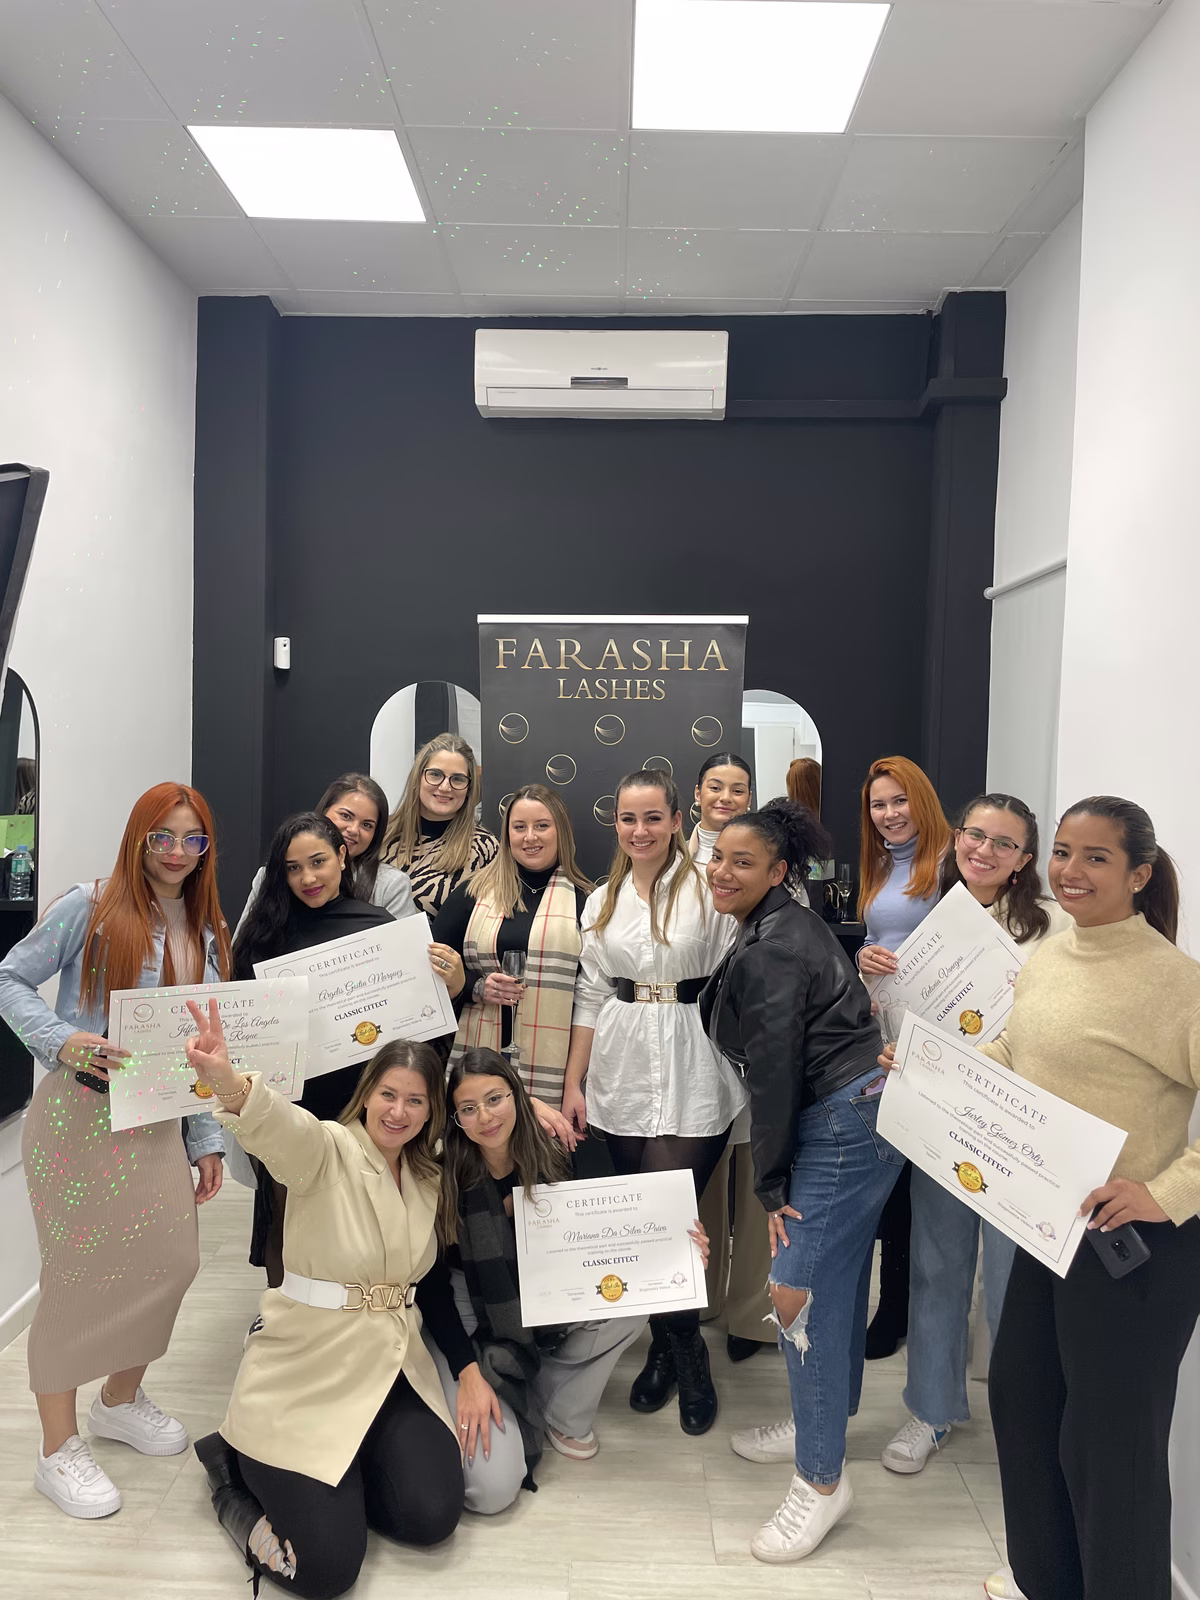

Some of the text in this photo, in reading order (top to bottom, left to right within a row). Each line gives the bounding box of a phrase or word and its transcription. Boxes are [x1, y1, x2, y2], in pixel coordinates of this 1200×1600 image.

[495, 638, 728, 671] FARASHA
[557, 678, 666, 700] LASHES
[309, 944, 382, 972] CERTIFICATE
[894, 932, 942, 985] CERTIFICATE
[329, 966, 350, 975] certificate
[171, 999, 254, 1014] CETIICATE
[335, 999, 387, 1021] CLASSIC EFFECT
[937, 982, 974, 1021] CLASSIC EFFECT
[251, 1016, 279, 1029] Angeles
[912, 1051, 944, 1075] FARASHA
[958, 1064, 1047, 1124] CERTIFICATE
[963, 1080, 973, 1090] This
[973, 1088, 999, 1107] certificate
[1004, 1109, 1028, 1126] awarded
[973, 1130, 983, 1138] part
[987, 1122, 1018, 1149] Gómez
[1019, 1144, 1044, 1166] Ortiz
[949, 1131, 1012, 1177] CLASSIC EFFECT
[566, 1193, 642, 1208] CERTIFICATE
[528, 1218, 560, 1226] FARASHA
[563, 1222, 666, 1243] Mariana Da Silva Paiva
[583, 1255, 639, 1267] CLASSIC EFFECT
